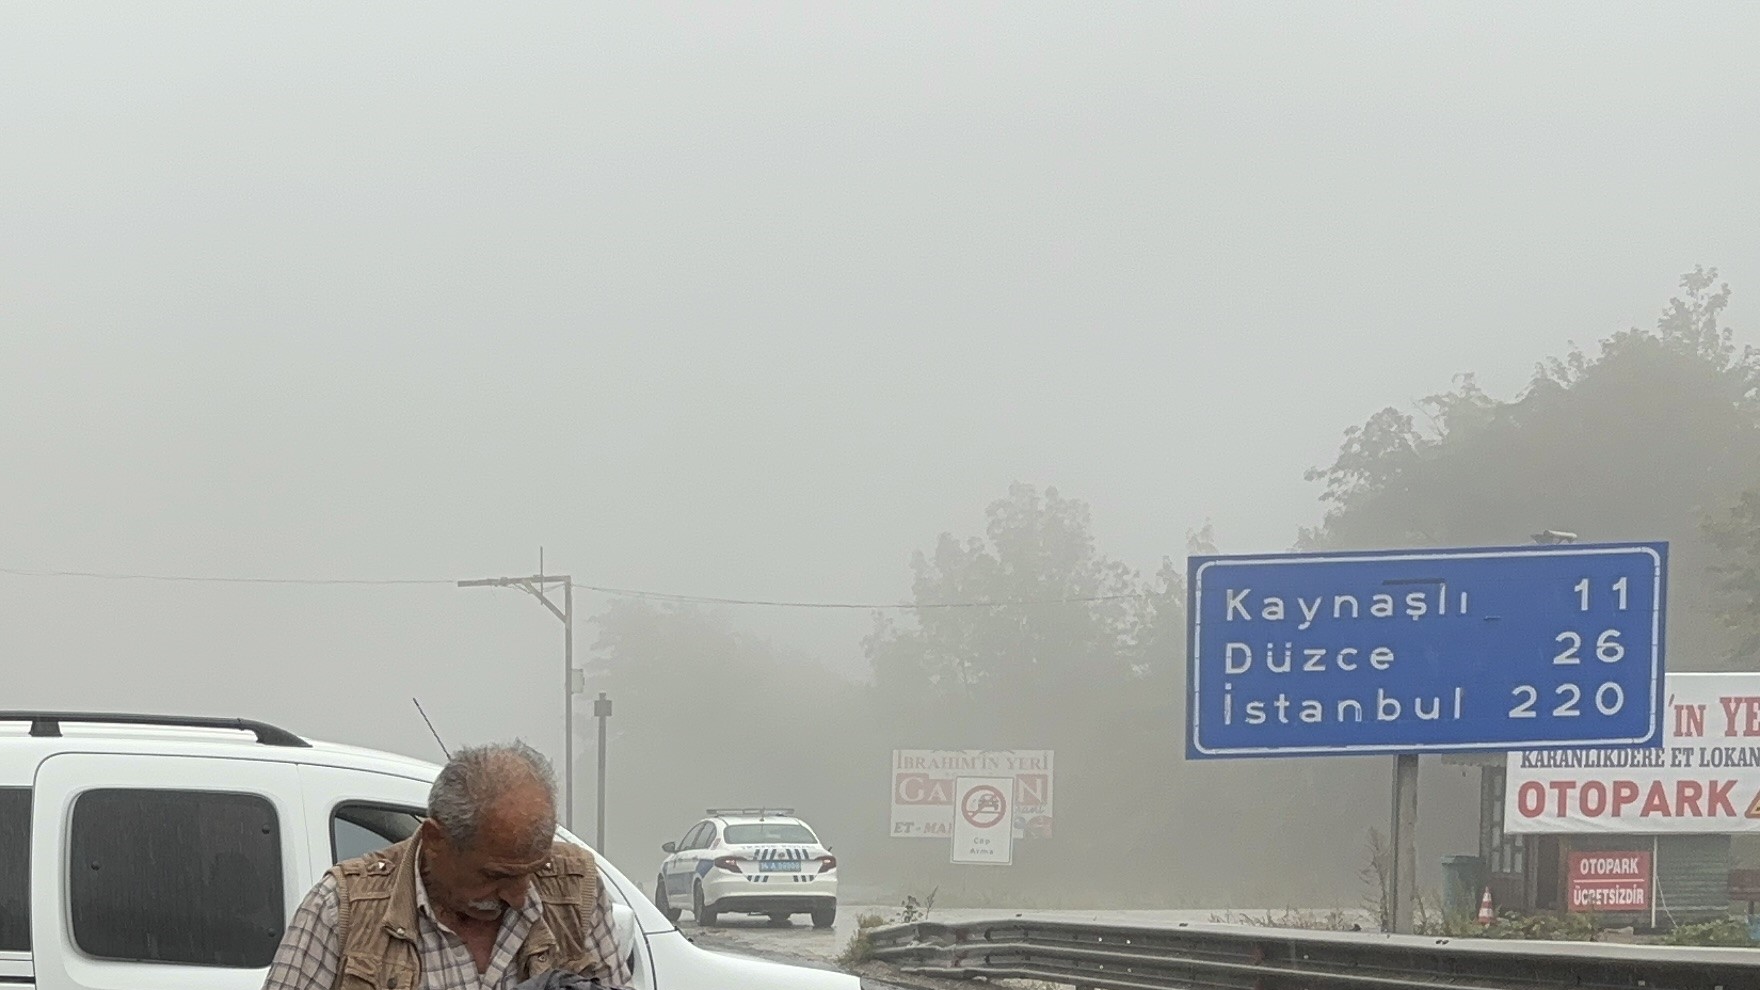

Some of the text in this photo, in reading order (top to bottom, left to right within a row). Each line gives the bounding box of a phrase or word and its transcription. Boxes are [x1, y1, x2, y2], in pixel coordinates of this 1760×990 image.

[1225, 576, 1629, 630] Kaynaşlı 11
[1224, 629, 1626, 675] Düzce 26
[1223, 682, 1625, 726] İstanbul 220
[1670, 746, 1695, 768] ET
[1698, 746, 1760, 768] LOKAN
[1518, 779, 1738, 818] OTOPARK
[1580, 857, 1640, 875] OTOPARK
